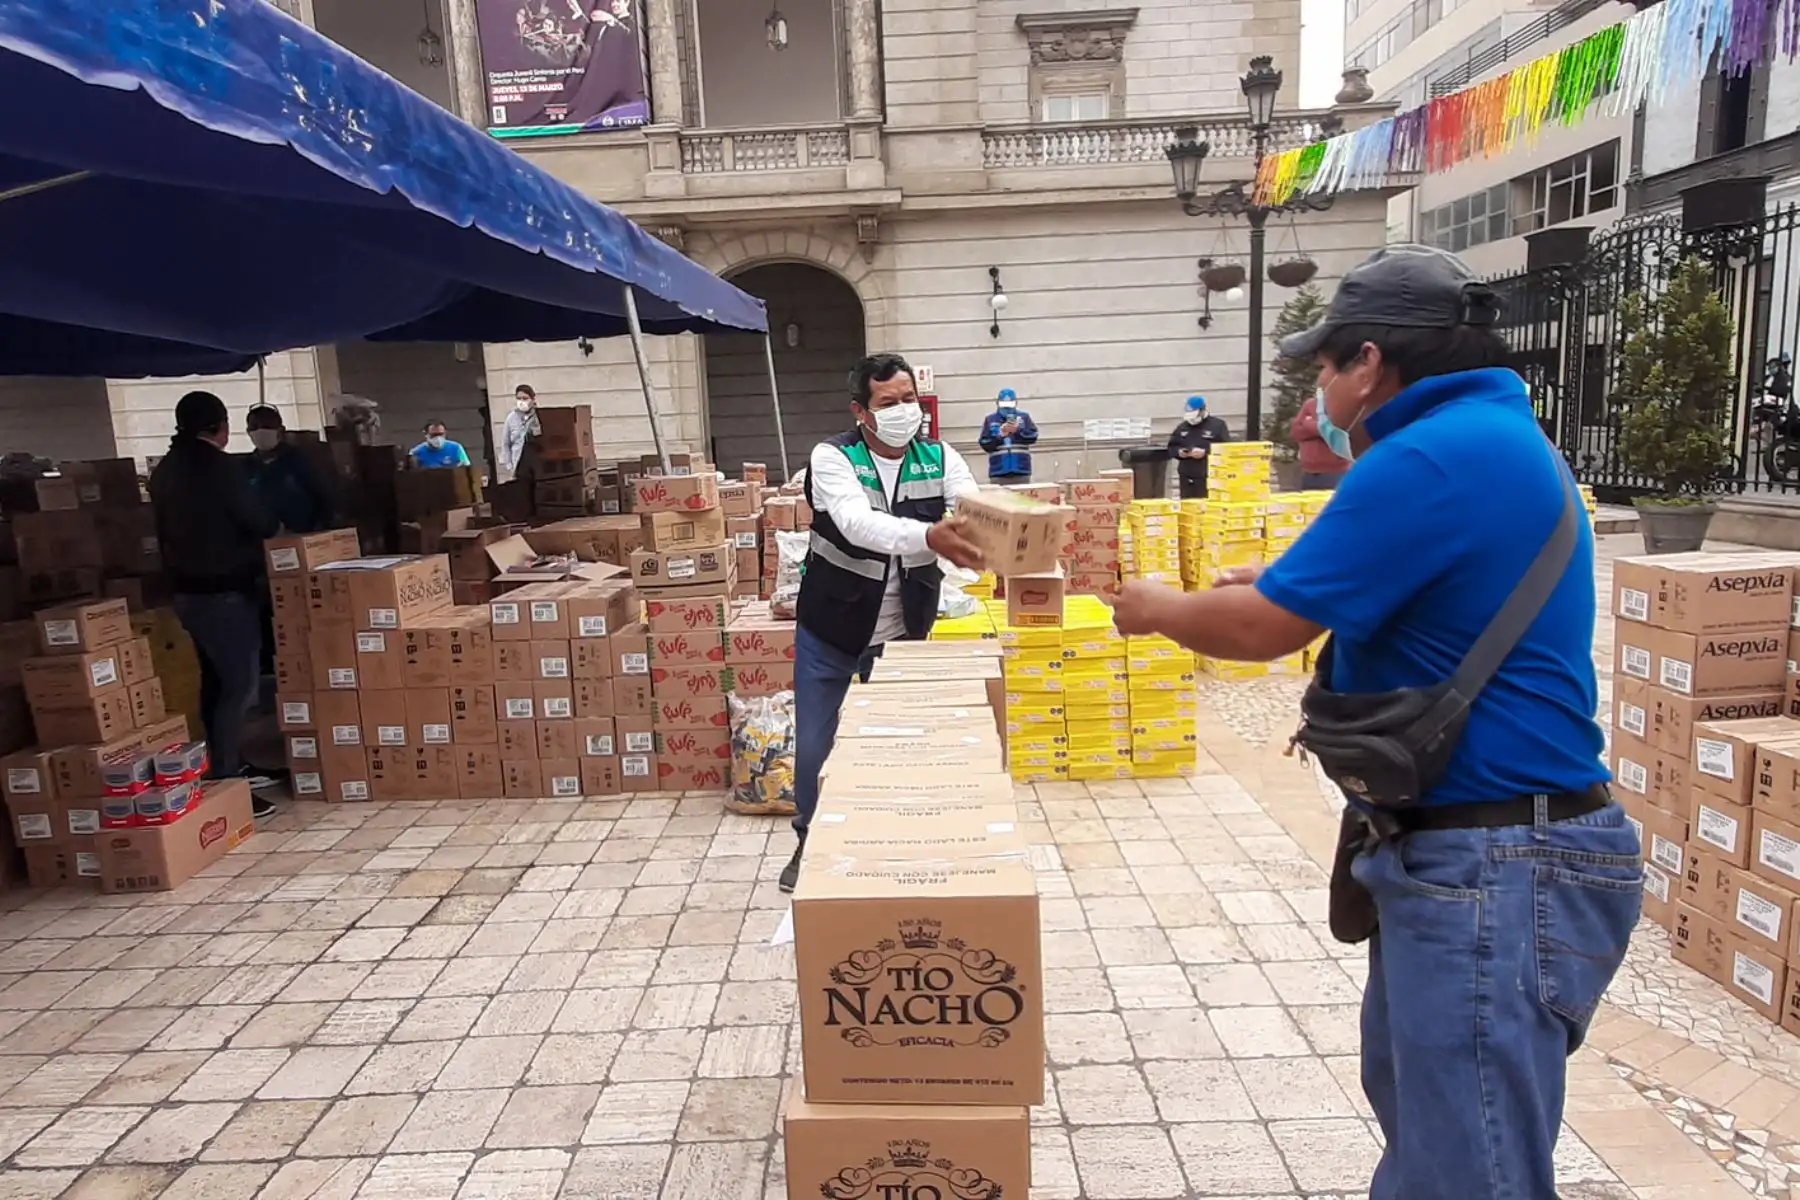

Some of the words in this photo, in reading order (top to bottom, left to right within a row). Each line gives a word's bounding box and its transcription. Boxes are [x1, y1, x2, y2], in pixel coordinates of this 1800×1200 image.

[1705, 572, 1785, 594] Asepxia
[1700, 637, 1779, 657] Asepxia
[846, 870, 901, 878] CUIDADO
[887, 960, 954, 992] TÍO
[822, 985, 1024, 1027] NACHO
[876, 1179, 942, 1200] TÍO
